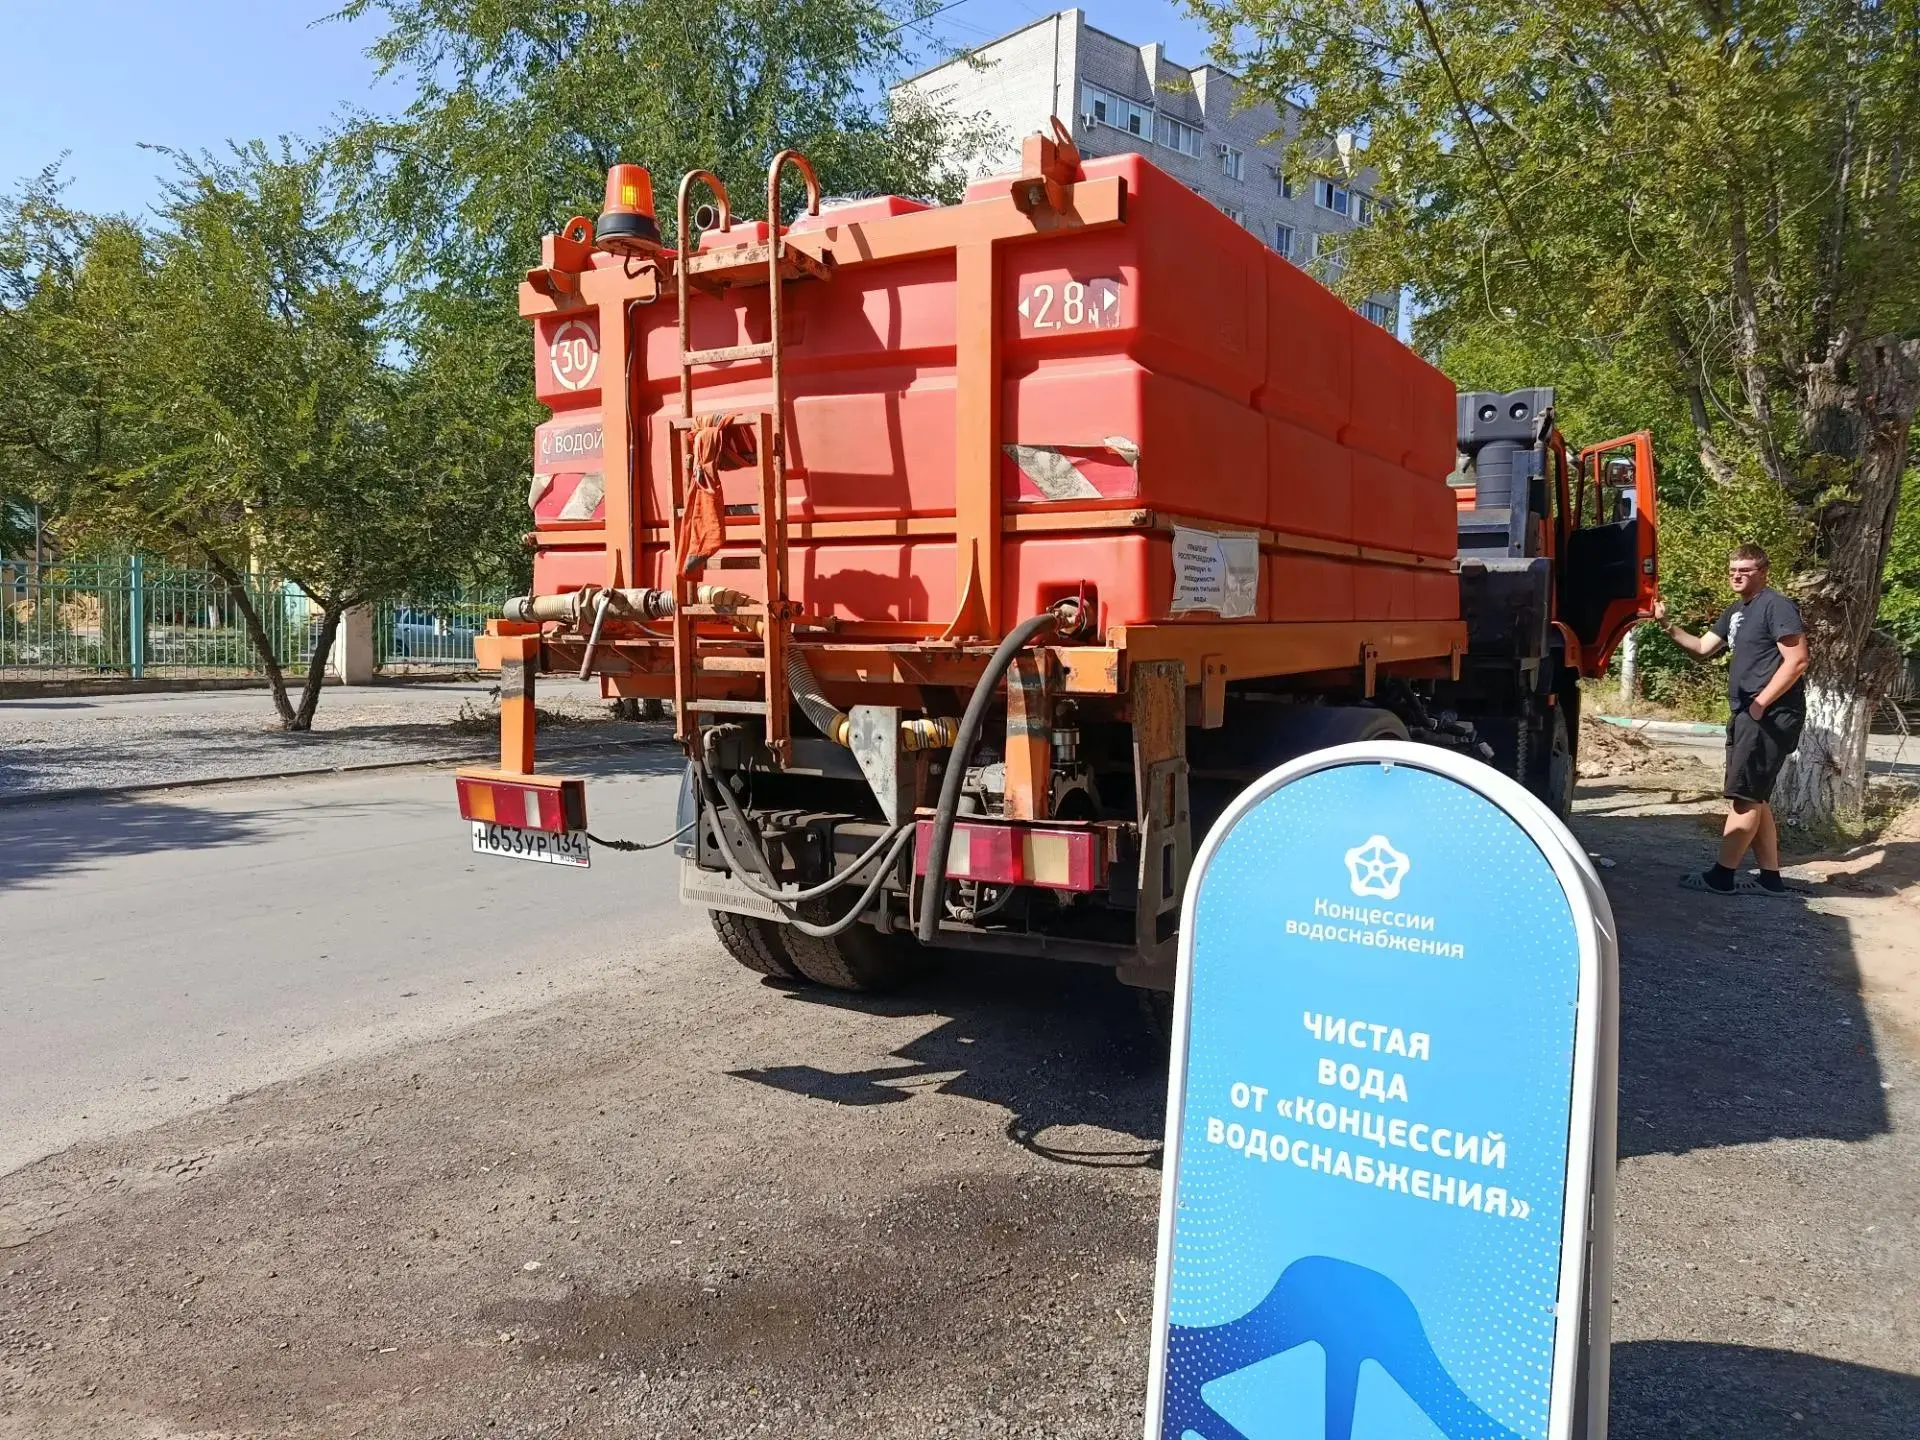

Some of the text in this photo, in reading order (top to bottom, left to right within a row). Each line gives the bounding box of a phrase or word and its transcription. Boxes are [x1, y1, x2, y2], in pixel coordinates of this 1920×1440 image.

[1033, 281, 1084, 330] 2,8
[560, 338, 588, 374] 30
[555, 428, 604, 455] ВОДОЙ
[552, 832, 582, 854] 134
[1314, 897, 1435, 931] Концессии
[1286, 919, 1465, 960] водоснабжения
[1303, 1011, 1431, 1061] ЧИСТАЯ
[1317, 1057, 1409, 1103] ВОДА
[1230, 1081, 1507, 1169] ОТ «КОНЦЕССИЙ
[1206, 1116, 1531, 1220] ВОДОСНАБЖЕНИЯ»
